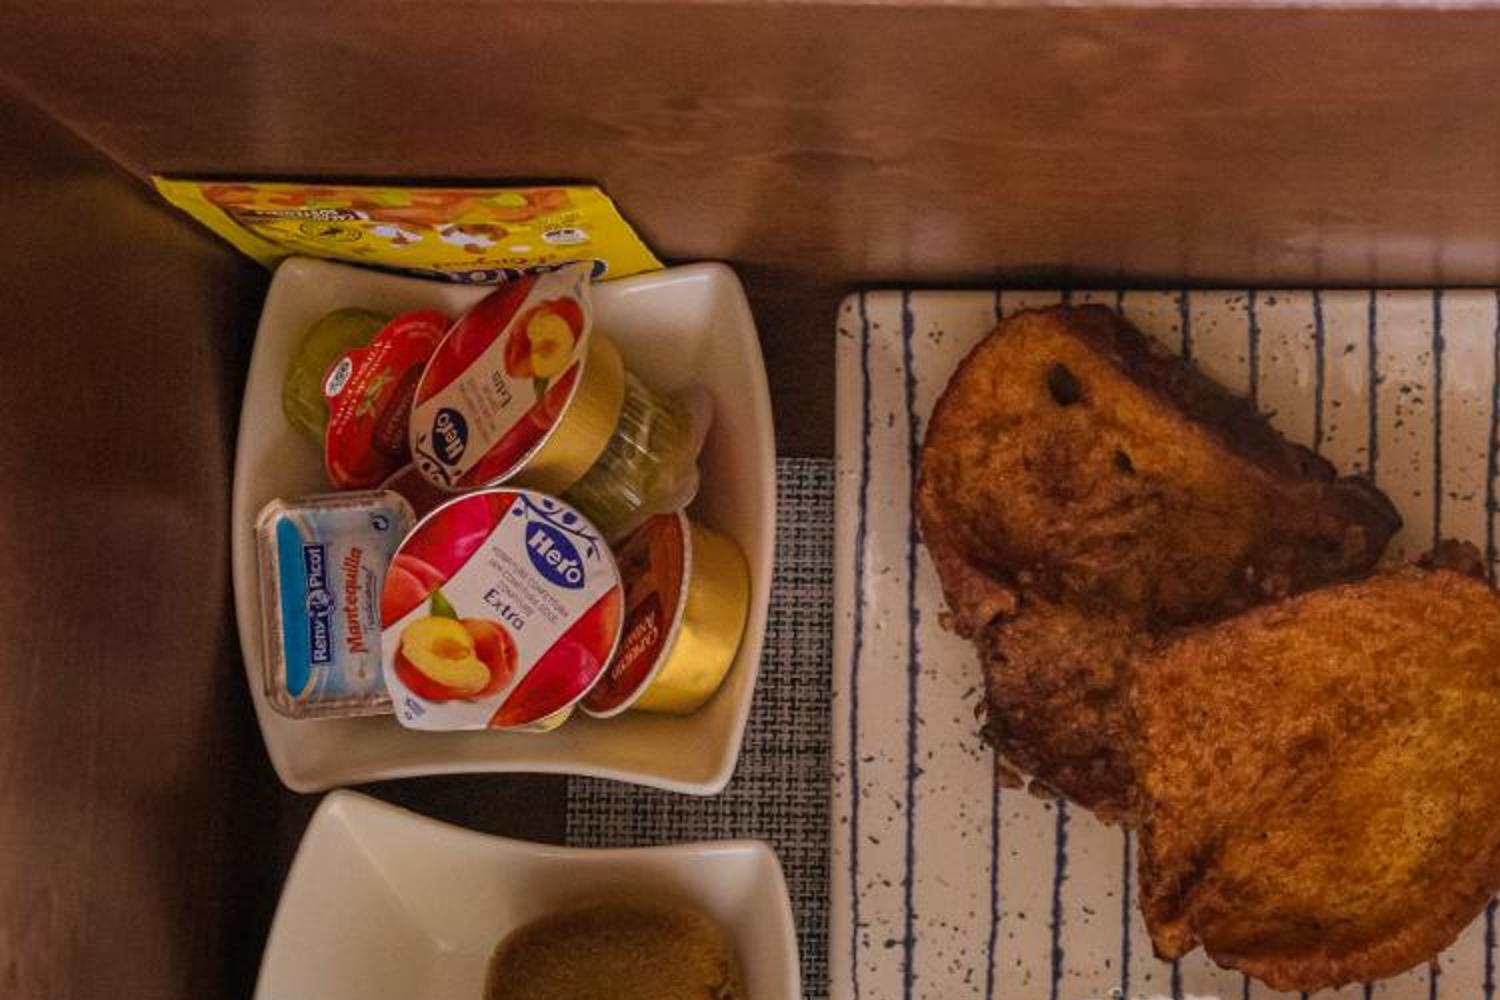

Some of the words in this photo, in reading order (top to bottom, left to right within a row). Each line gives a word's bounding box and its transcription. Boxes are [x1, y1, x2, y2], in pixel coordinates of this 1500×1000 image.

[436, 413, 466, 460] Hero
[309, 548, 321, 588] Picot
[528, 529, 582, 583] Hero
[348, 545, 364, 654] Mantequilla
[483, 588, 526, 630] Extra
[314, 619, 326, 661] Reny
